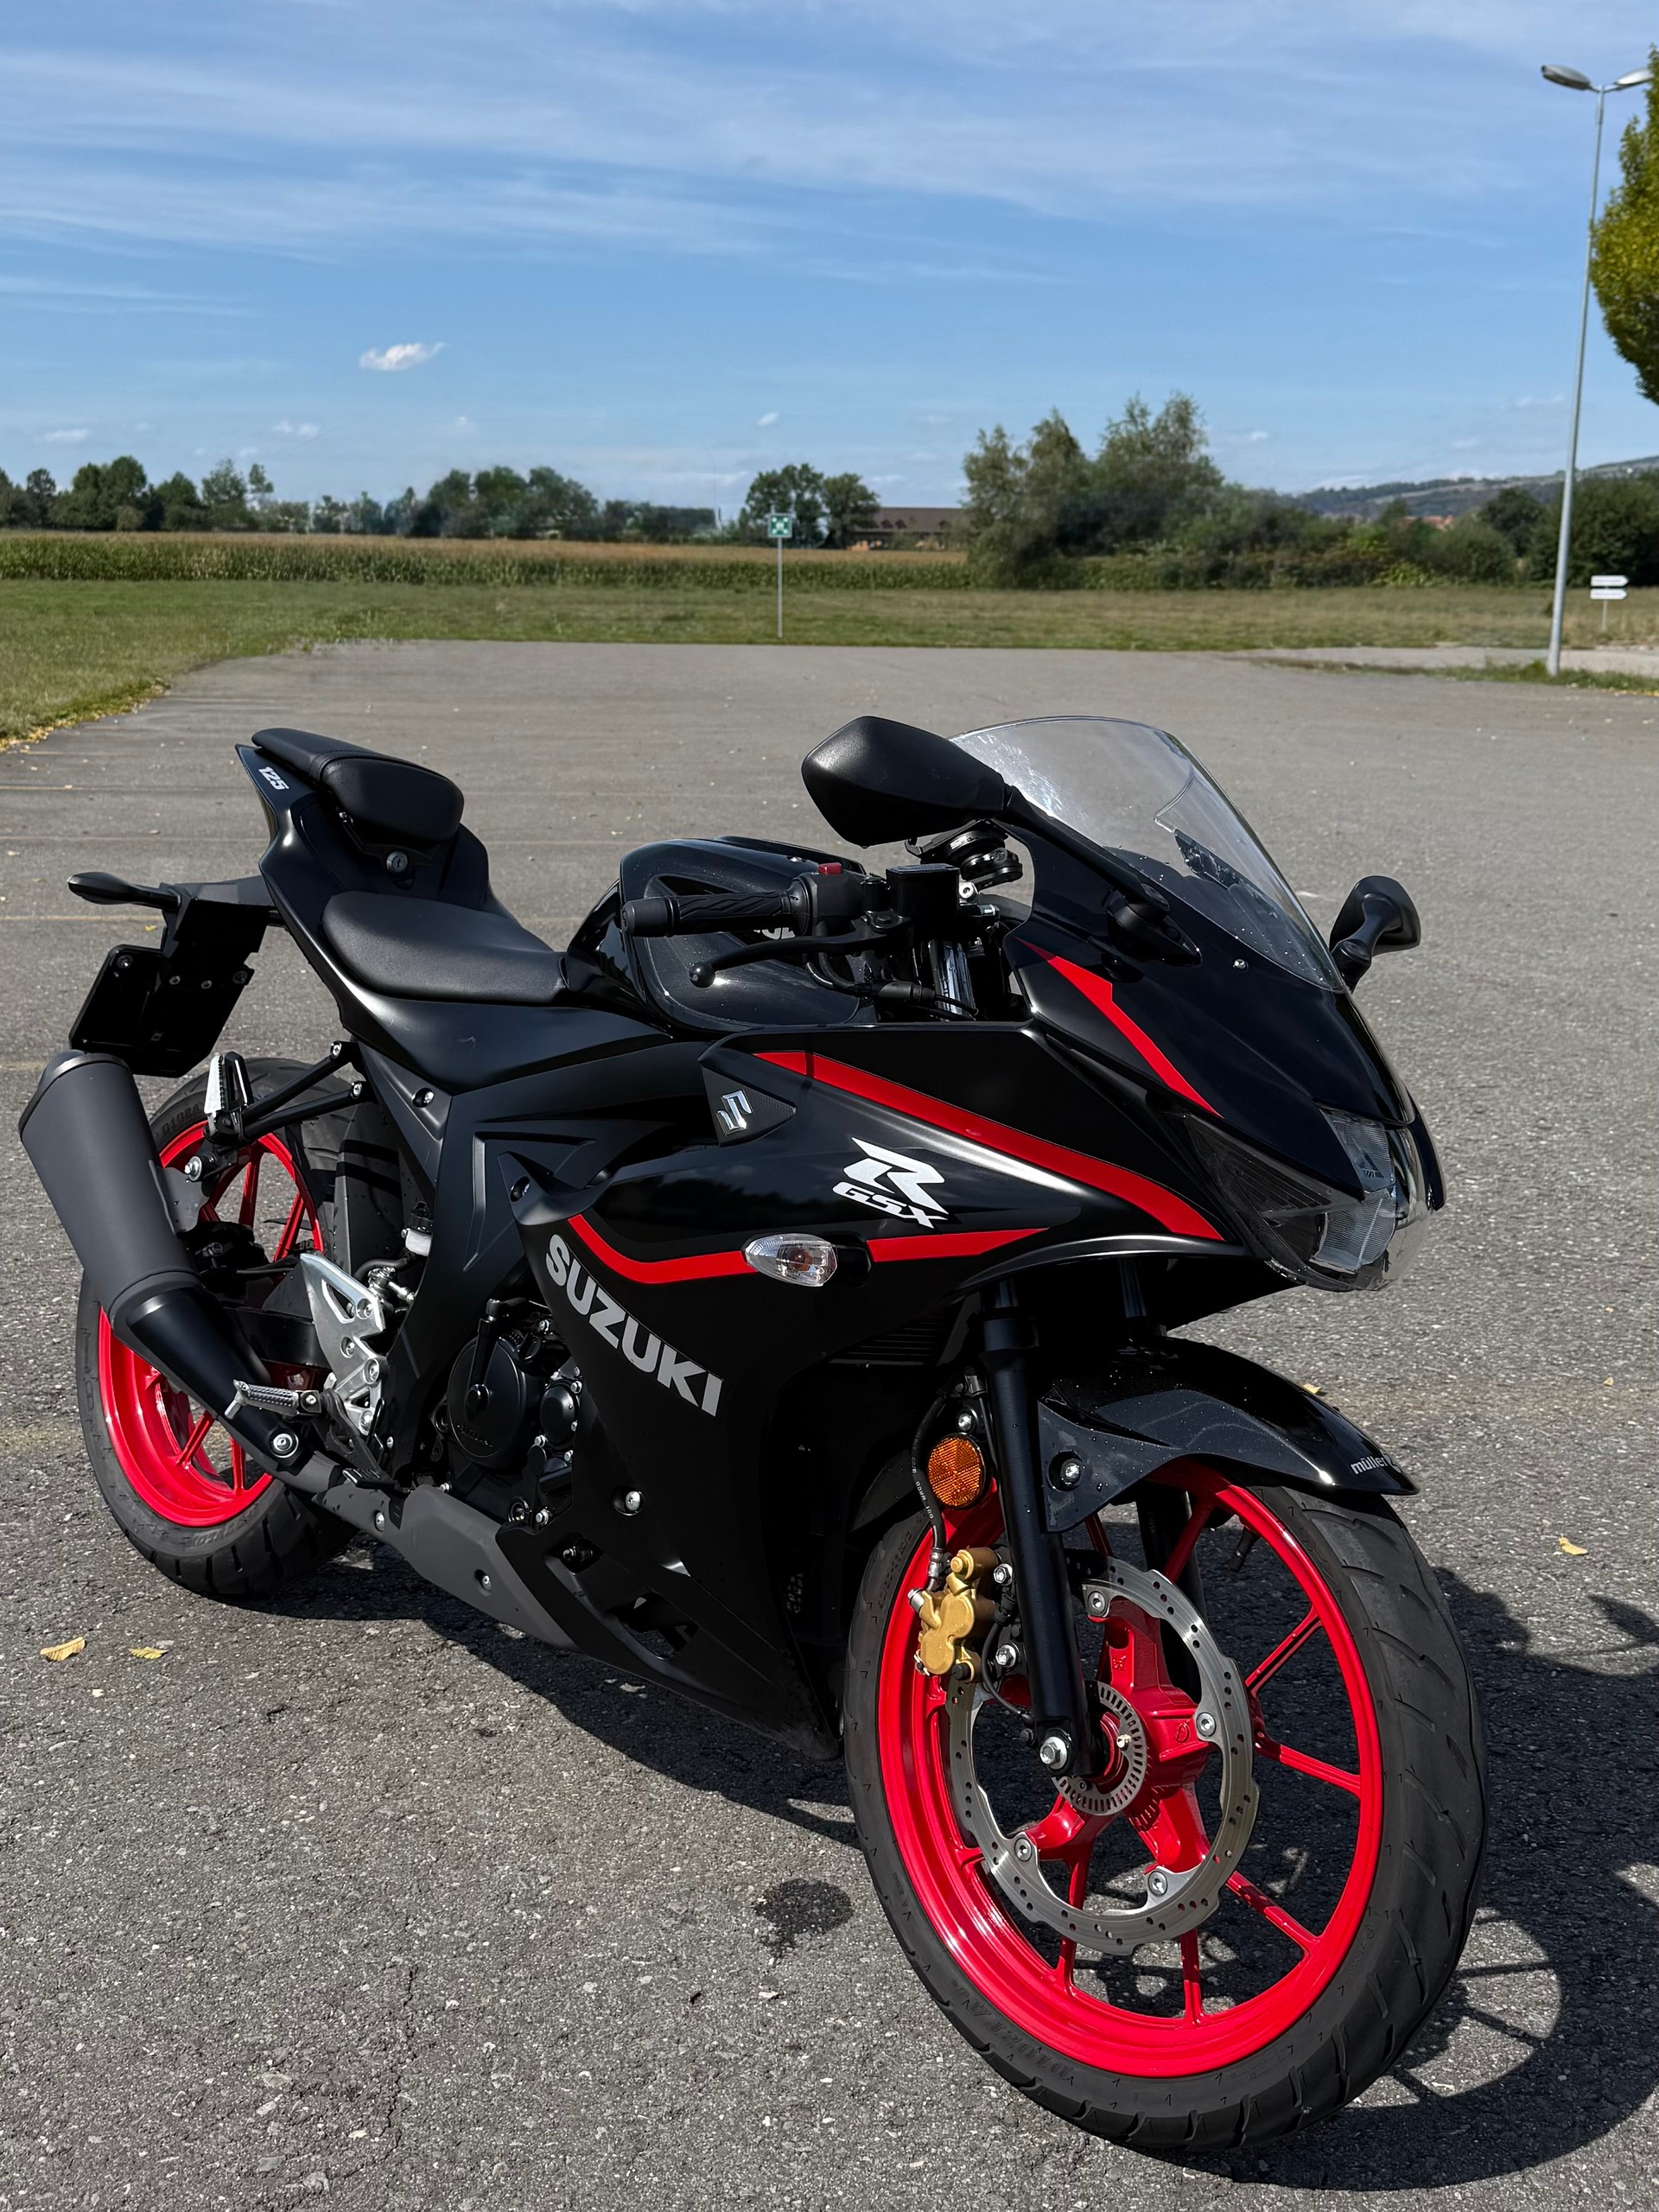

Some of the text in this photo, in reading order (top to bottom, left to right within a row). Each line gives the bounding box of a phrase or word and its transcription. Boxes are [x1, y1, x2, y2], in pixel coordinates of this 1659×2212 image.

[258, 766, 289, 790] 125
[832, 1181, 948, 1229] GSX
[546, 1234, 723, 1417] SUZUKI
[1351, 1456, 1388, 1475] müller
